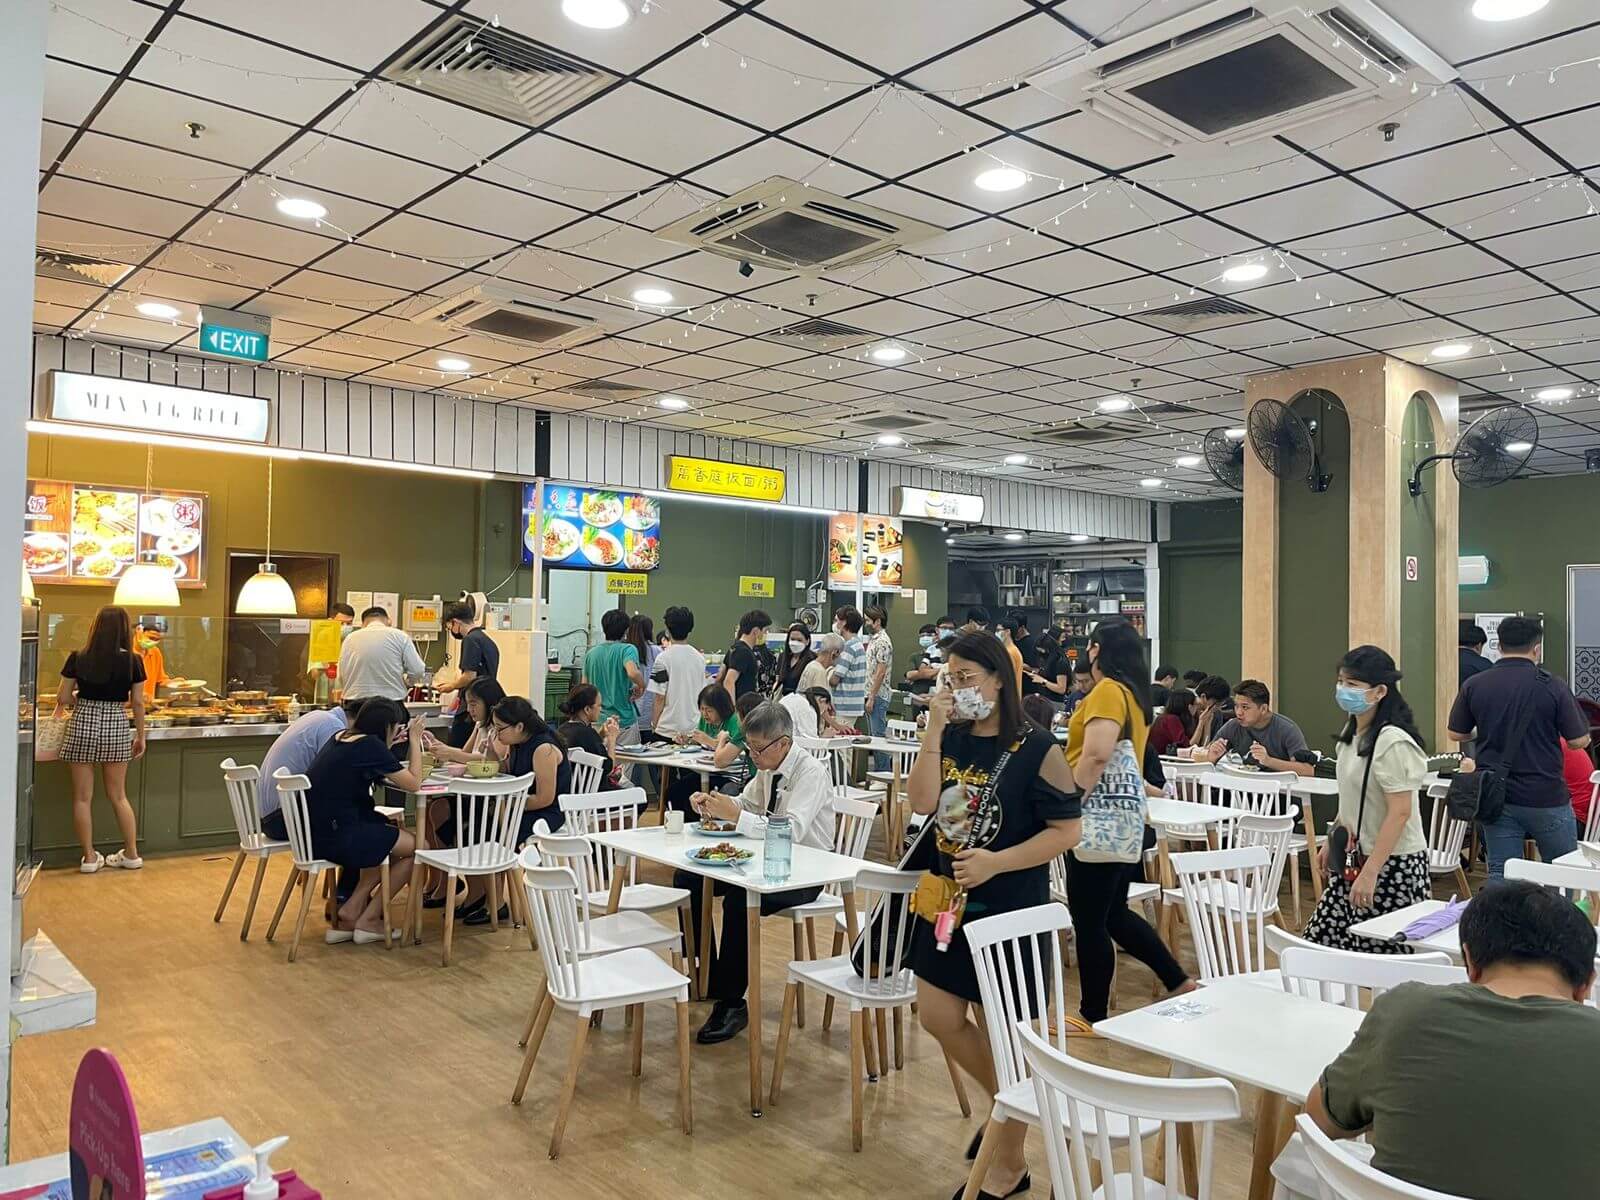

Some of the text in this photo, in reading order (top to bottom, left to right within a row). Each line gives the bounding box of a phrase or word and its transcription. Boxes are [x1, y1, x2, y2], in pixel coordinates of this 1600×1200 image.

[220, 331, 260, 356] EXIT
[86, 391, 126, 412] MIX
[978, 787, 993, 816] POOH
